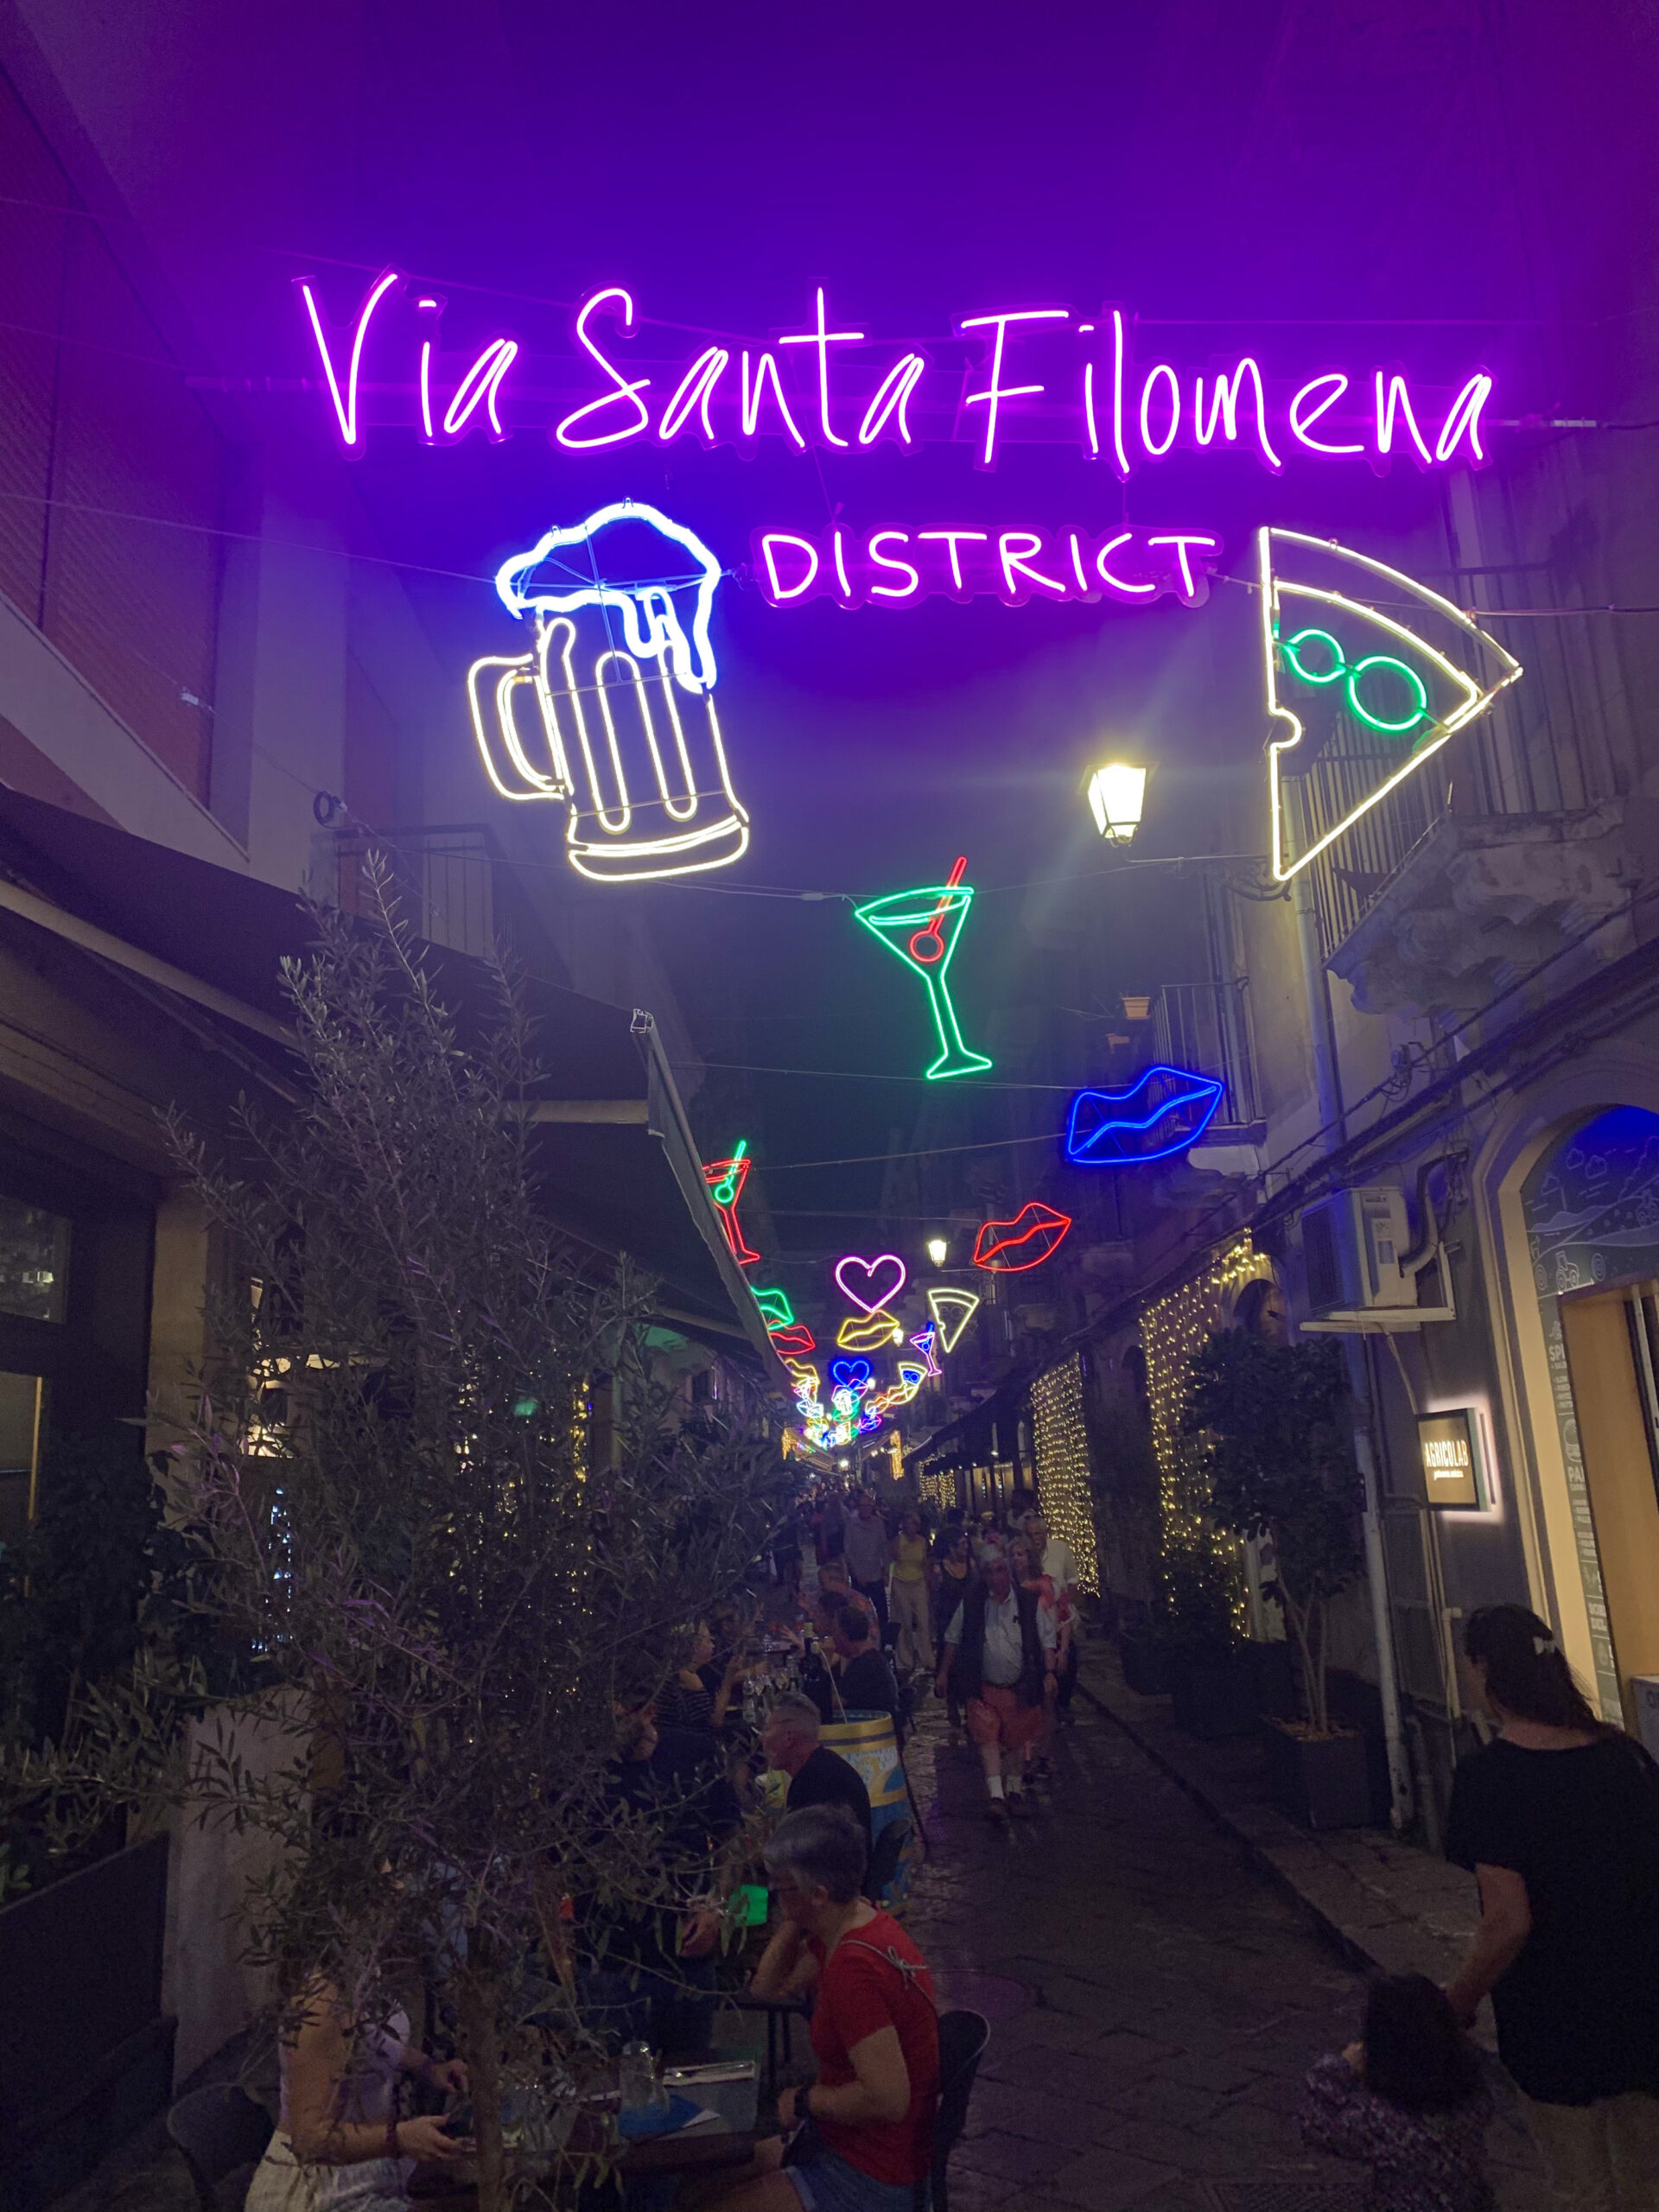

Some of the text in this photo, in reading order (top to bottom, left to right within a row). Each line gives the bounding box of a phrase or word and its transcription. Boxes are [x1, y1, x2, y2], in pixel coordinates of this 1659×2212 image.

[301, 272, 1492, 474] Via Santa Filomena
[760, 530, 1217, 601] DISTRICT
[1425, 1440, 1469, 1467] AGRICOLAB
